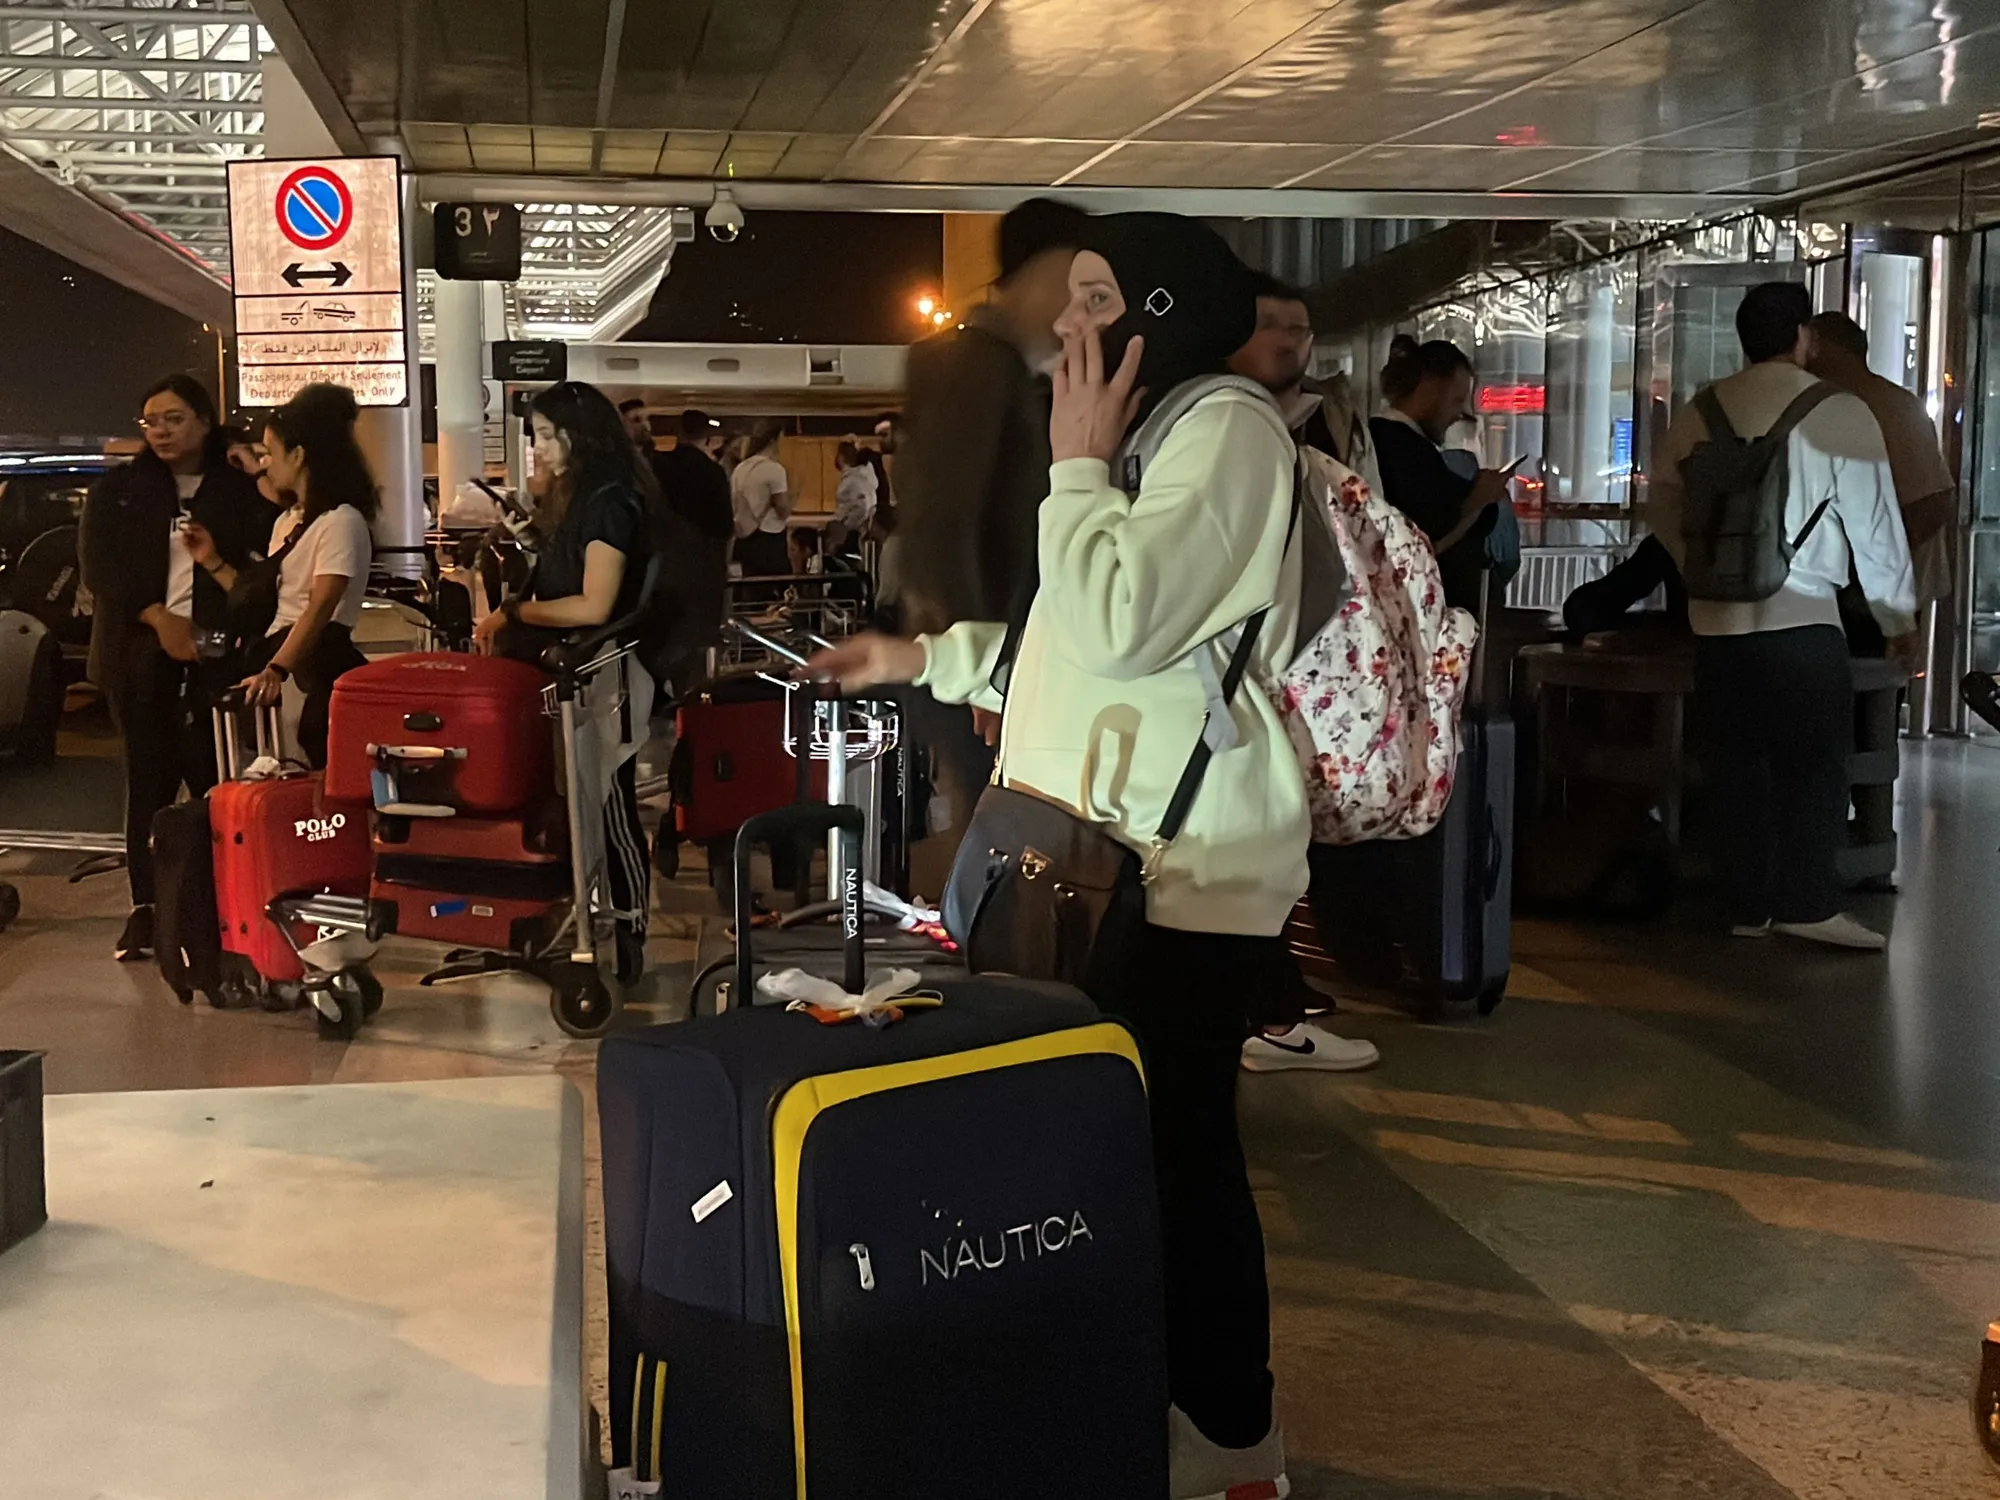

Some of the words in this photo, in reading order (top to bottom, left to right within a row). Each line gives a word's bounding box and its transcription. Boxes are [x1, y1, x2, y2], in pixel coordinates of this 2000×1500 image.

[455, 206, 472, 237] 3
[371, 385, 396, 398] Only
[293, 812, 346, 837] POLO
[307, 828, 337, 842] CLUB
[845, 867, 859, 940] NAUTICA
[920, 1209, 1093, 1286] NAUTICA
